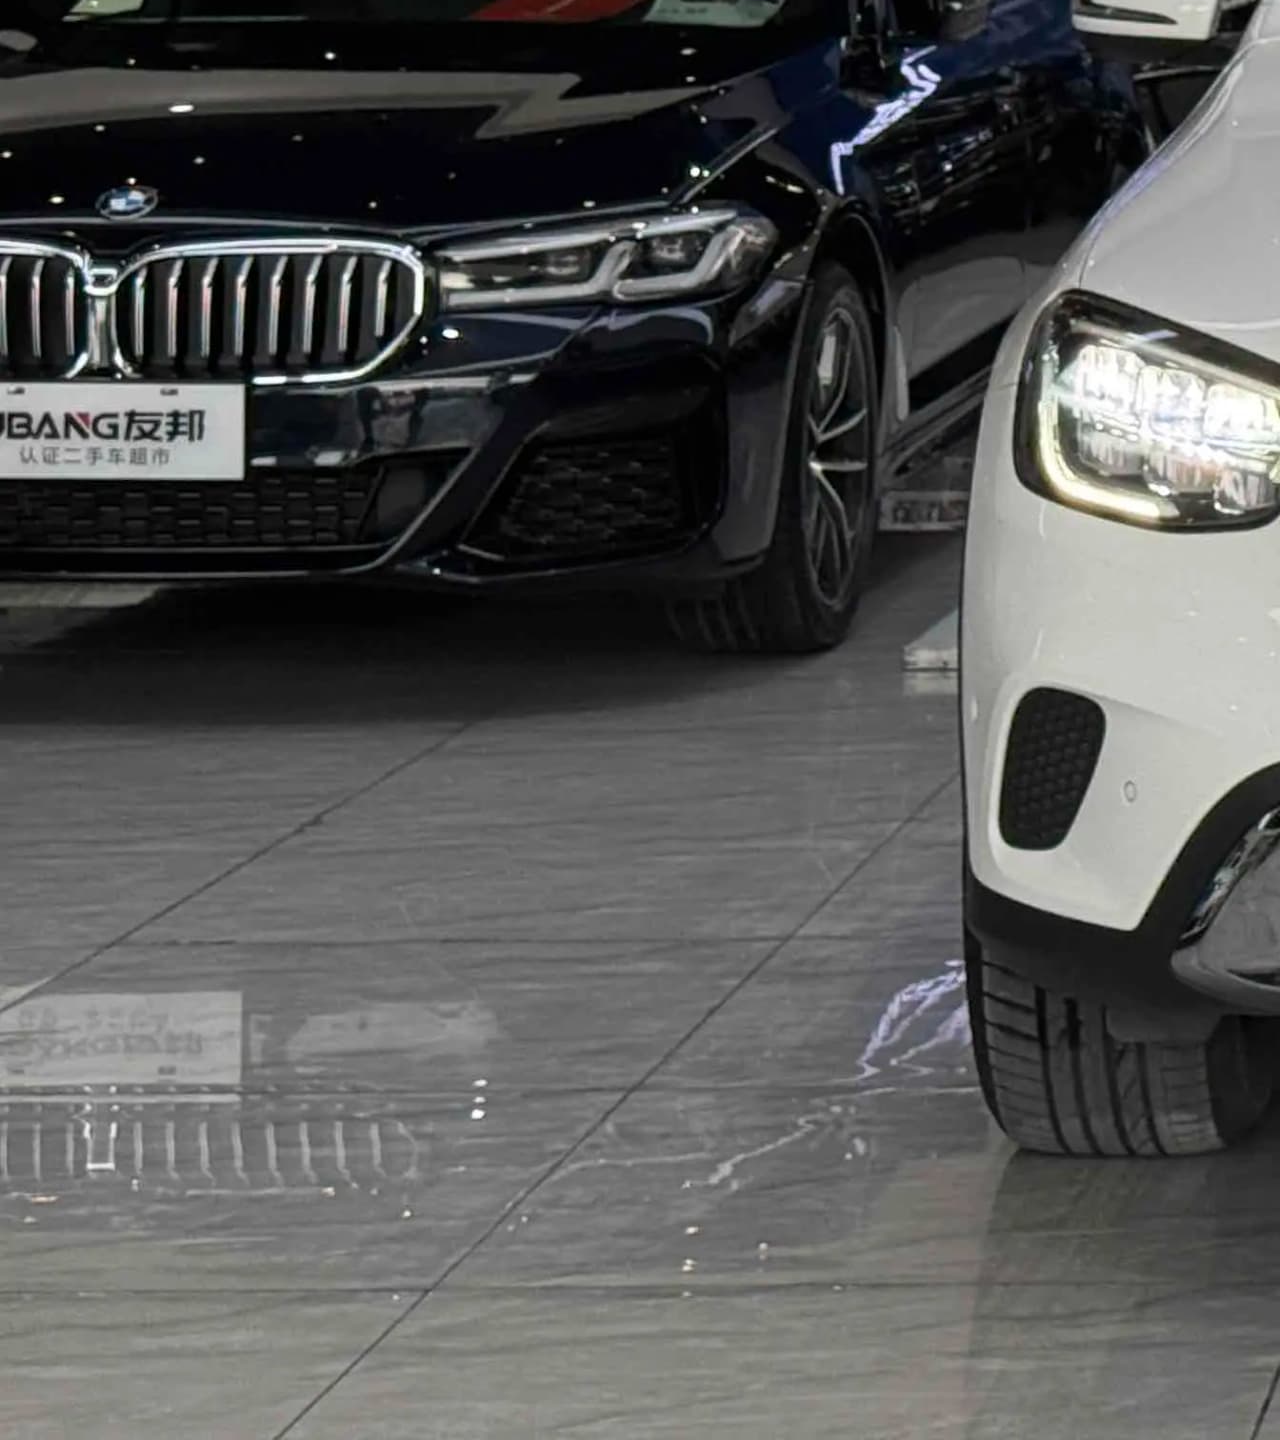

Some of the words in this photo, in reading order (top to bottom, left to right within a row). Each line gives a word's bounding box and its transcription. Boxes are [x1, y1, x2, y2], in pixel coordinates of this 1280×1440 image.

[0, 408, 206, 442] BANG友邦
[19, 446, 172, 468] 认证二手车超市
